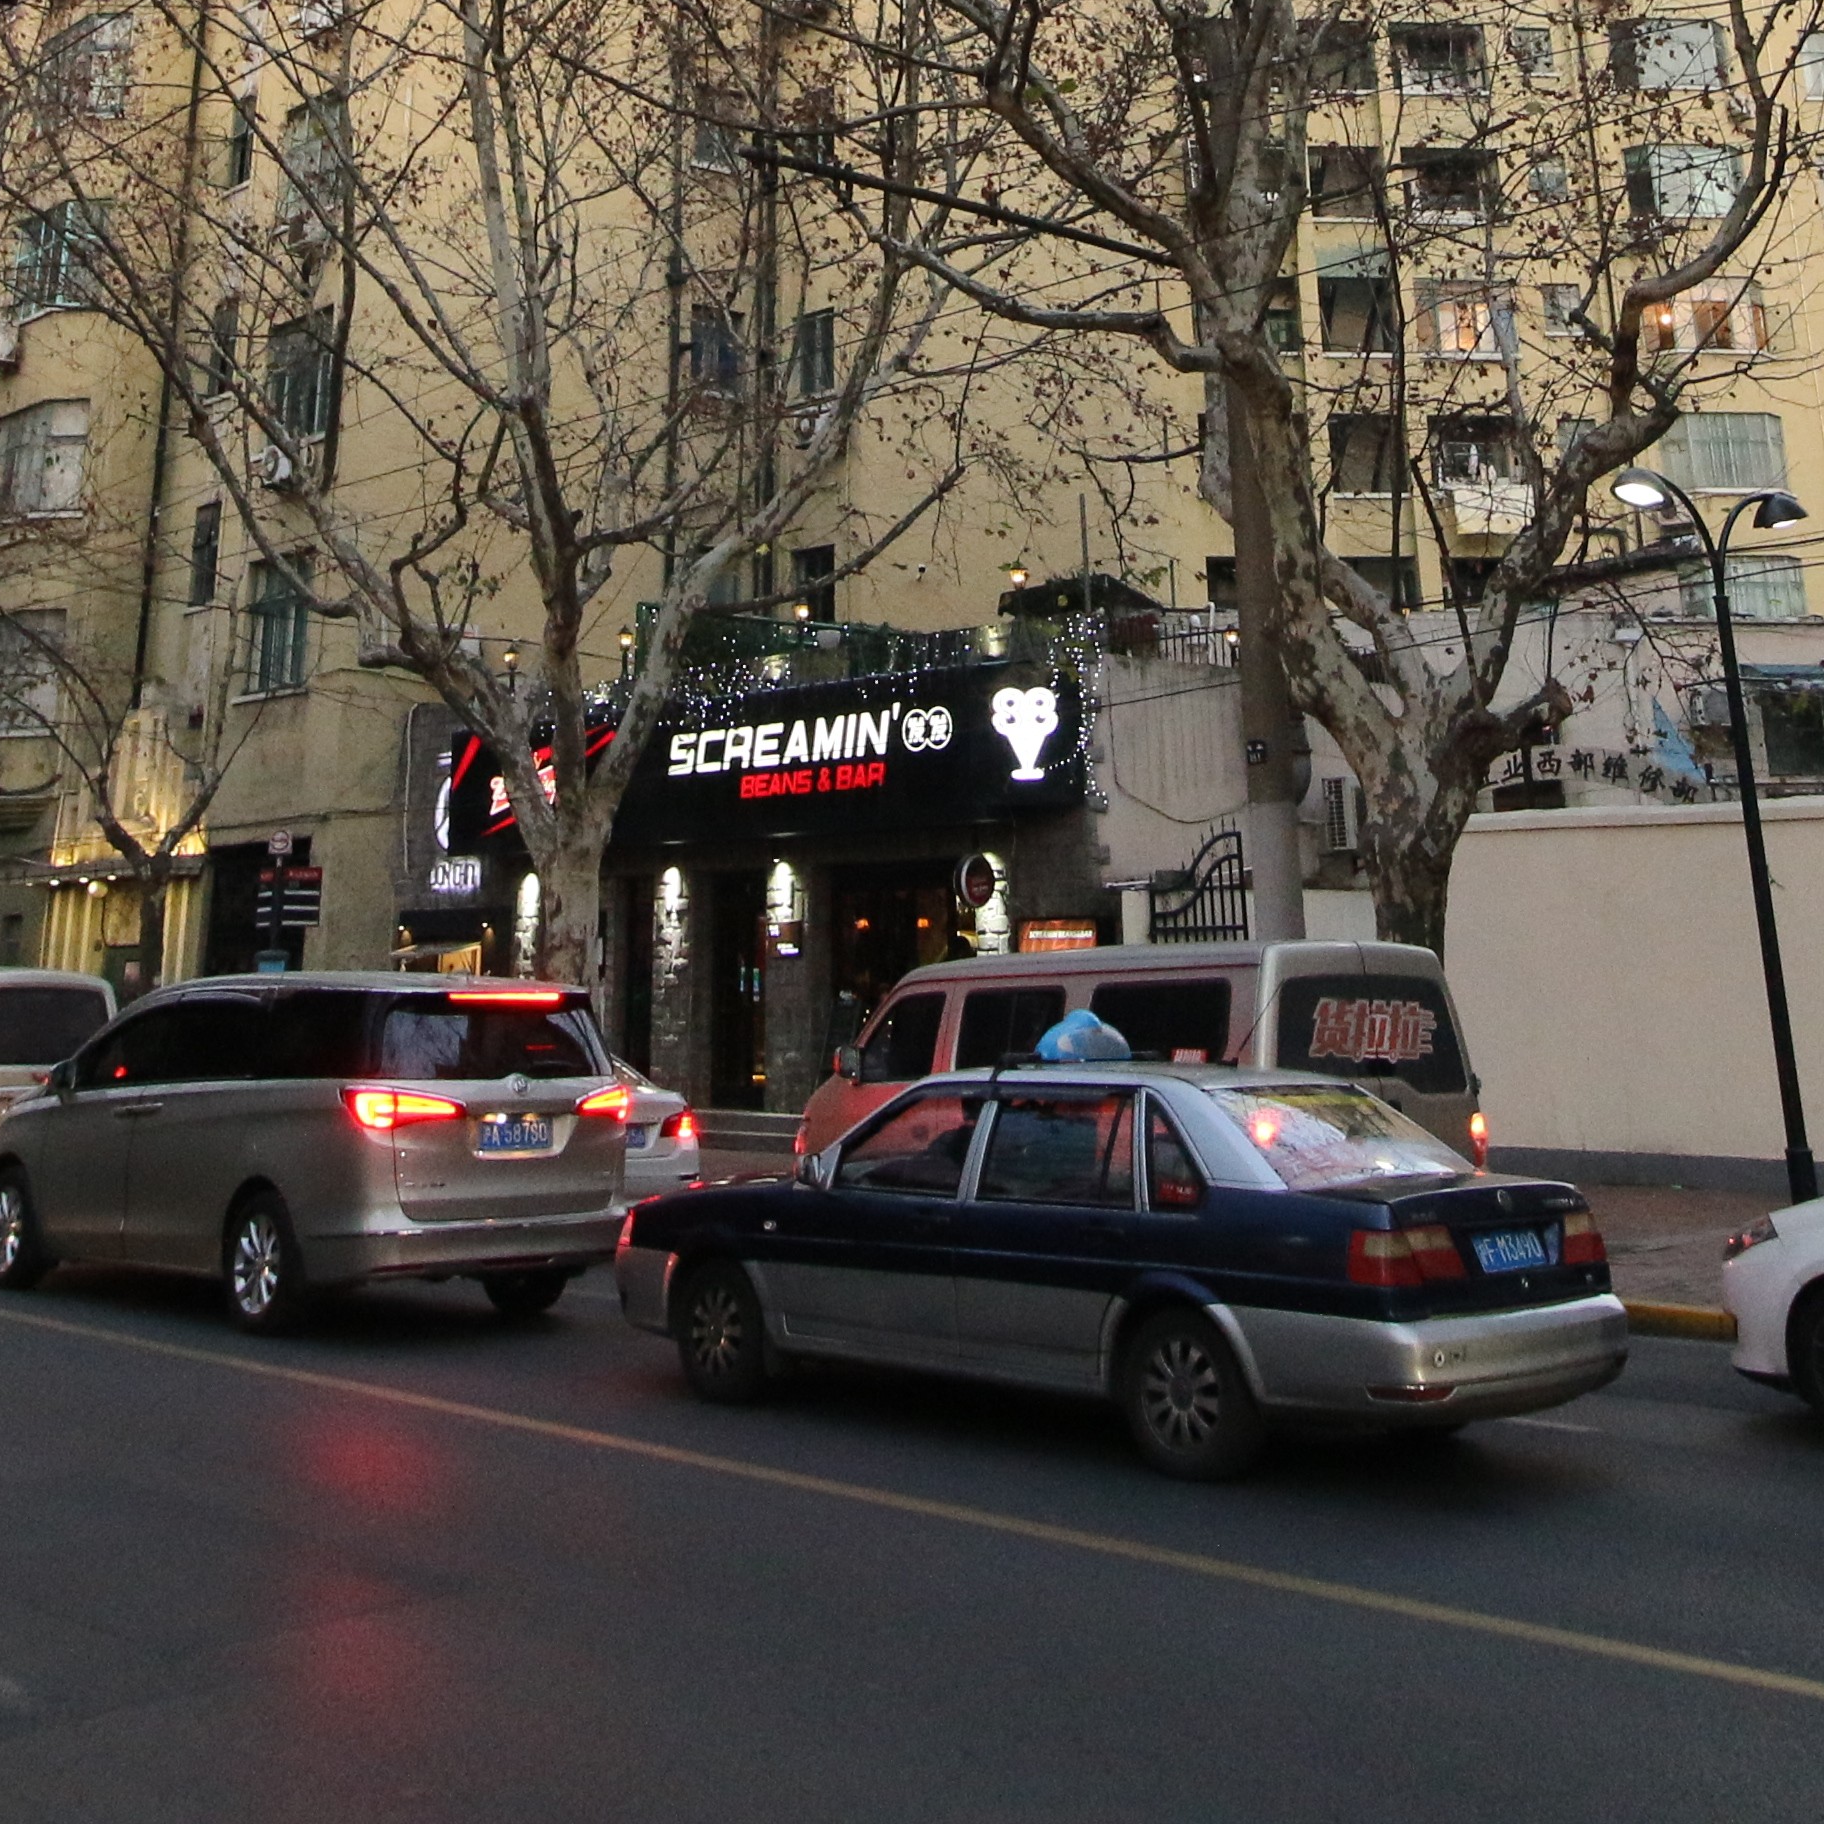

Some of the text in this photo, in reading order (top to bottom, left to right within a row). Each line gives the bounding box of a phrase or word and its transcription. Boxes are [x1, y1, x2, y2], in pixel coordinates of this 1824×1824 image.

[668, 702, 901, 776] SCREAMIN'
[740, 762, 887, 800] BEANS & BAR
[1308, 996, 1436, 1064] 货拉拉
